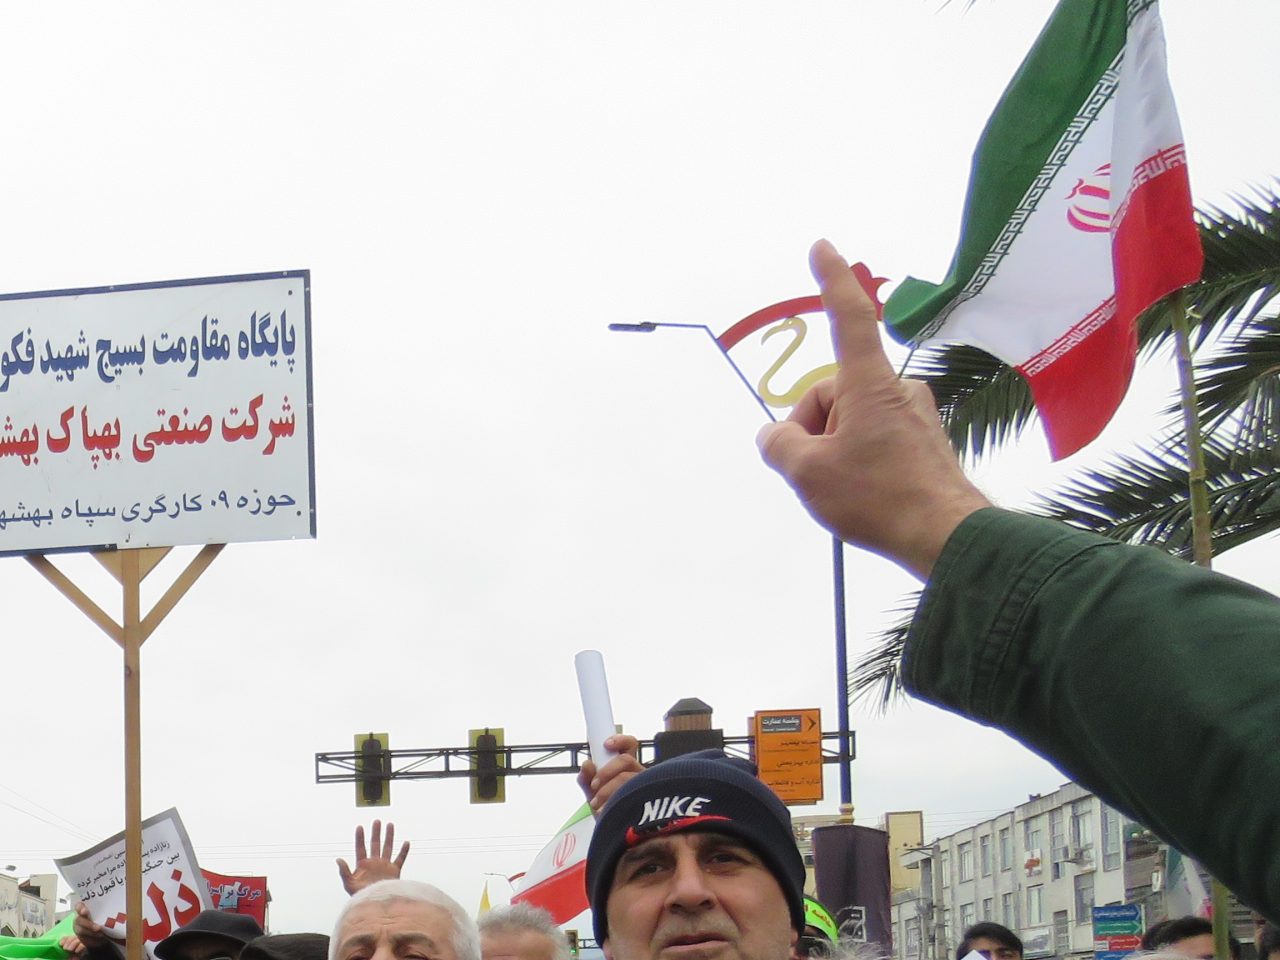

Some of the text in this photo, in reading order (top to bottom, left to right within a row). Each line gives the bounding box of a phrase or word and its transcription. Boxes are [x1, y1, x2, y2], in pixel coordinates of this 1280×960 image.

[39, 329, 90, 381] شهید
[95, 332, 147, 383] بسیج
[153, 315, 230, 378] مقاومت
[238, 310, 296, 373] پایگاه
[132, 408, 213, 463] صنعتی
[221, 394, 296, 454] شرکت
[61, 498, 116, 527] سپاه
[121, 493, 202, 522] کارگری
[236, 489, 296, 516] حوزه
[638, 796, 711, 825] NIKE
[166, 852, 180, 865] بین
[97, 878, 116, 896] قبول
